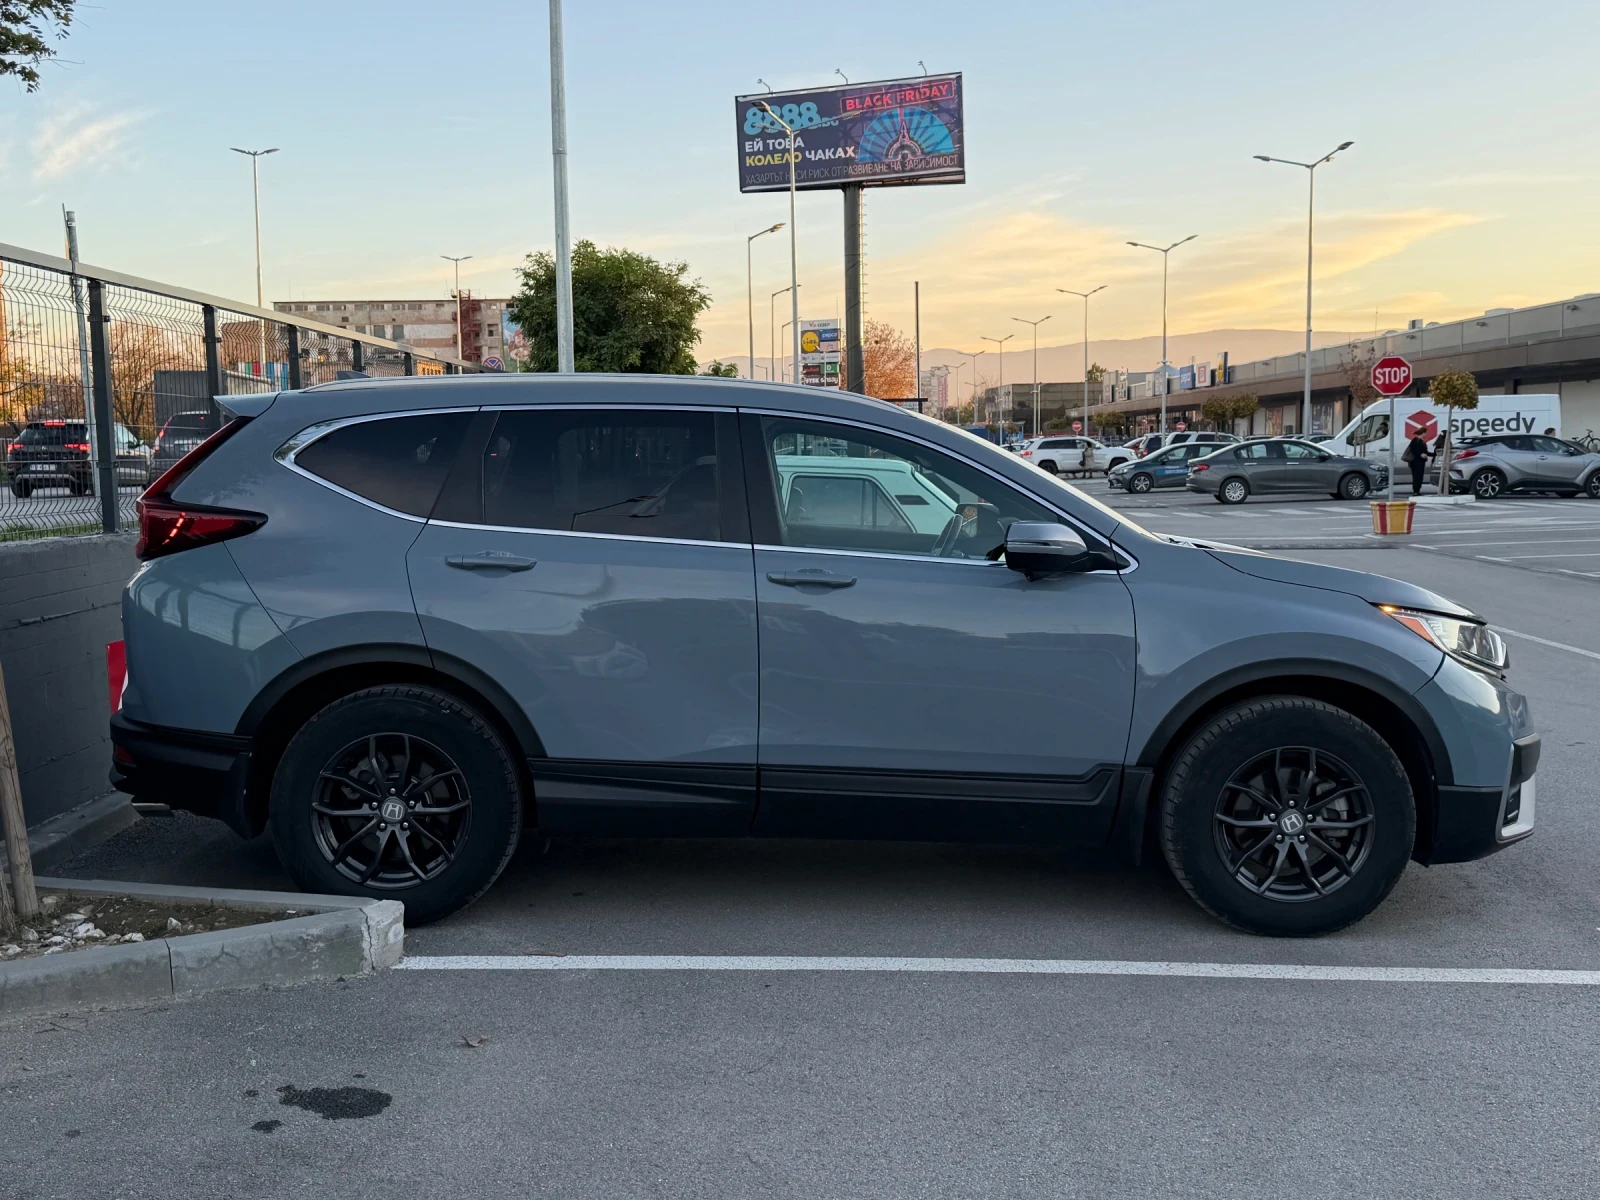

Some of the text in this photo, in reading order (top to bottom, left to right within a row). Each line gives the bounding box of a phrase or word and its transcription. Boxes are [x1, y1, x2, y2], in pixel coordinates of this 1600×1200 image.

[846, 85, 949, 111] BLACK FRIDAY
[744, 136, 805, 152] ЕЙ ТОВА
[745, 151, 803, 167] КОЛЕЛО
[745, 155, 959, 184] ХАЗАРТЪТ НСИ РИСК ОТ РАЗВИВАНЕ НА ЗАВИСИМОСТ
[1375, 367, 1409, 385] STOP
[1450, 411, 1536, 438] speedy
